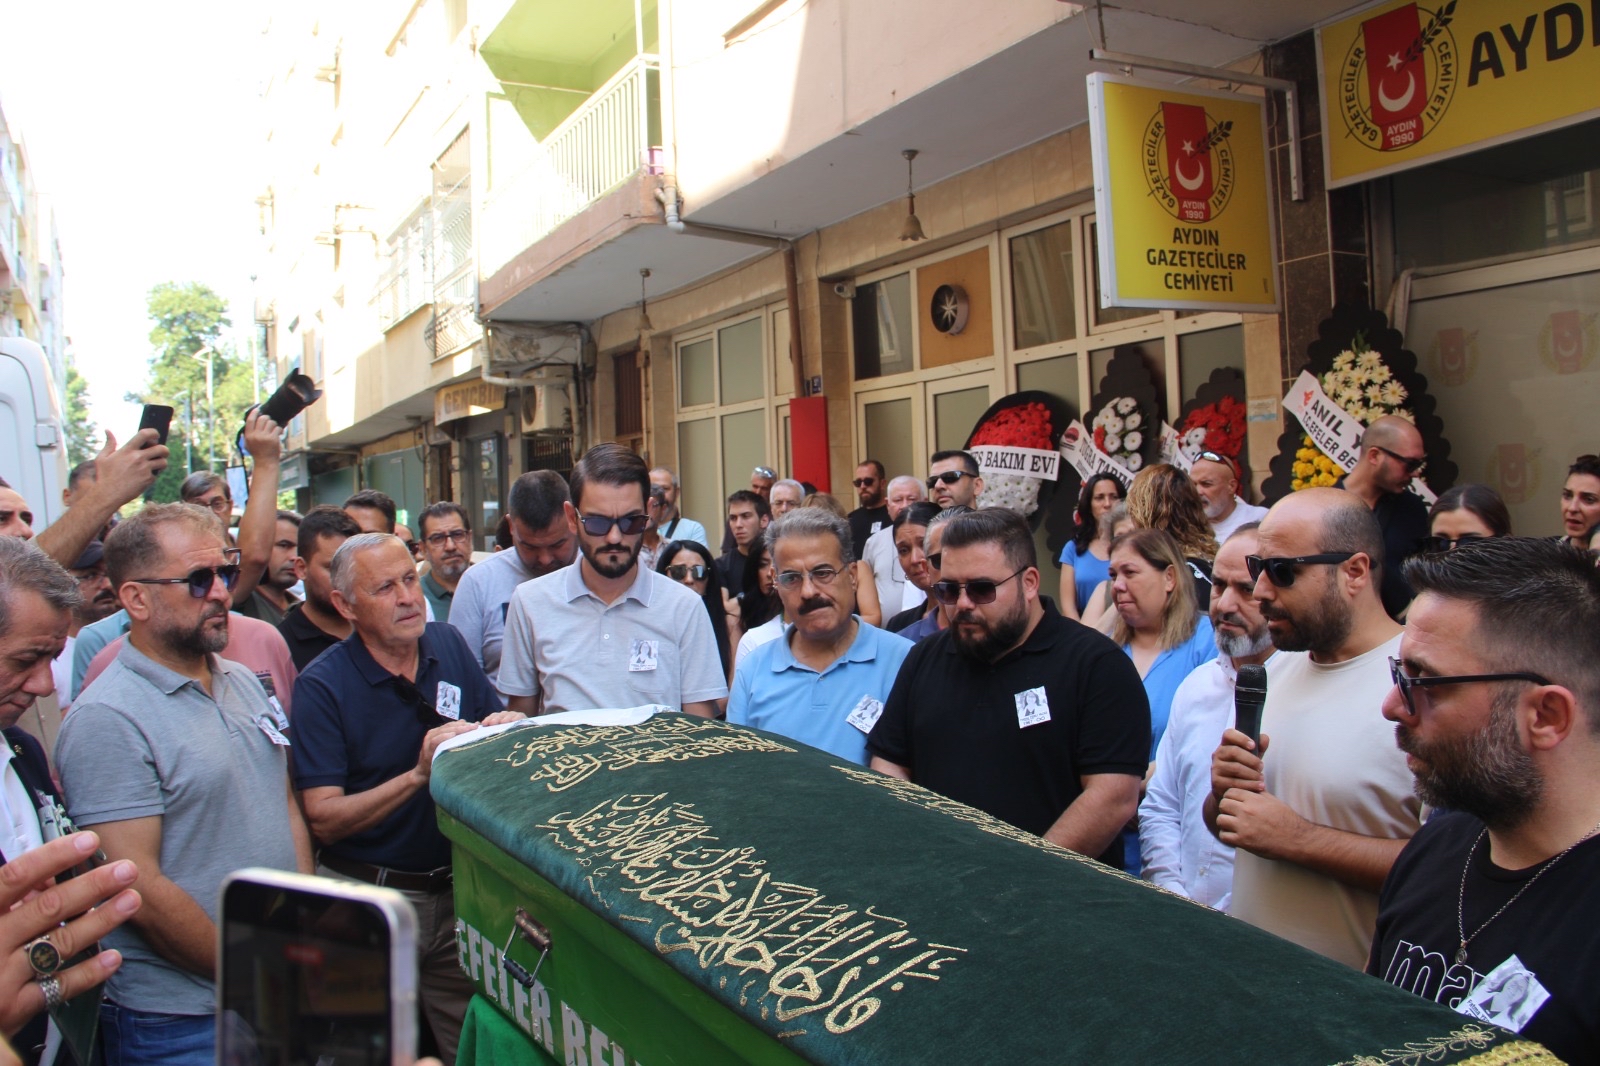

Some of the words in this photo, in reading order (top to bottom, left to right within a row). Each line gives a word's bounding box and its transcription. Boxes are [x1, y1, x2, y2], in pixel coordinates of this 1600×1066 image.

[1425, 41, 1454, 123] CEMİYETİ
[1344, 47, 1378, 141] GAZETECİLER
[1386, 119, 1417, 136] AYDIN
[1390, 131, 1414, 146] 1990
[1145, 121, 1175, 208] GAZETECİLER
[1212, 149, 1231, 210] CEMİYETİ
[1182, 200, 1206, 210] AYDIN
[1185, 210, 1204, 219] 1990
[1173, 227, 1219, 246] AYDIN
[1146, 248, 1246, 270] GAZETECİLER
[1164, 270, 1233, 292] CEMİYETİ
[1311, 399, 1344, 437] ANIL
[985, 451, 1026, 471] BAKIM
[1030, 453, 1056, 475] EVİ
